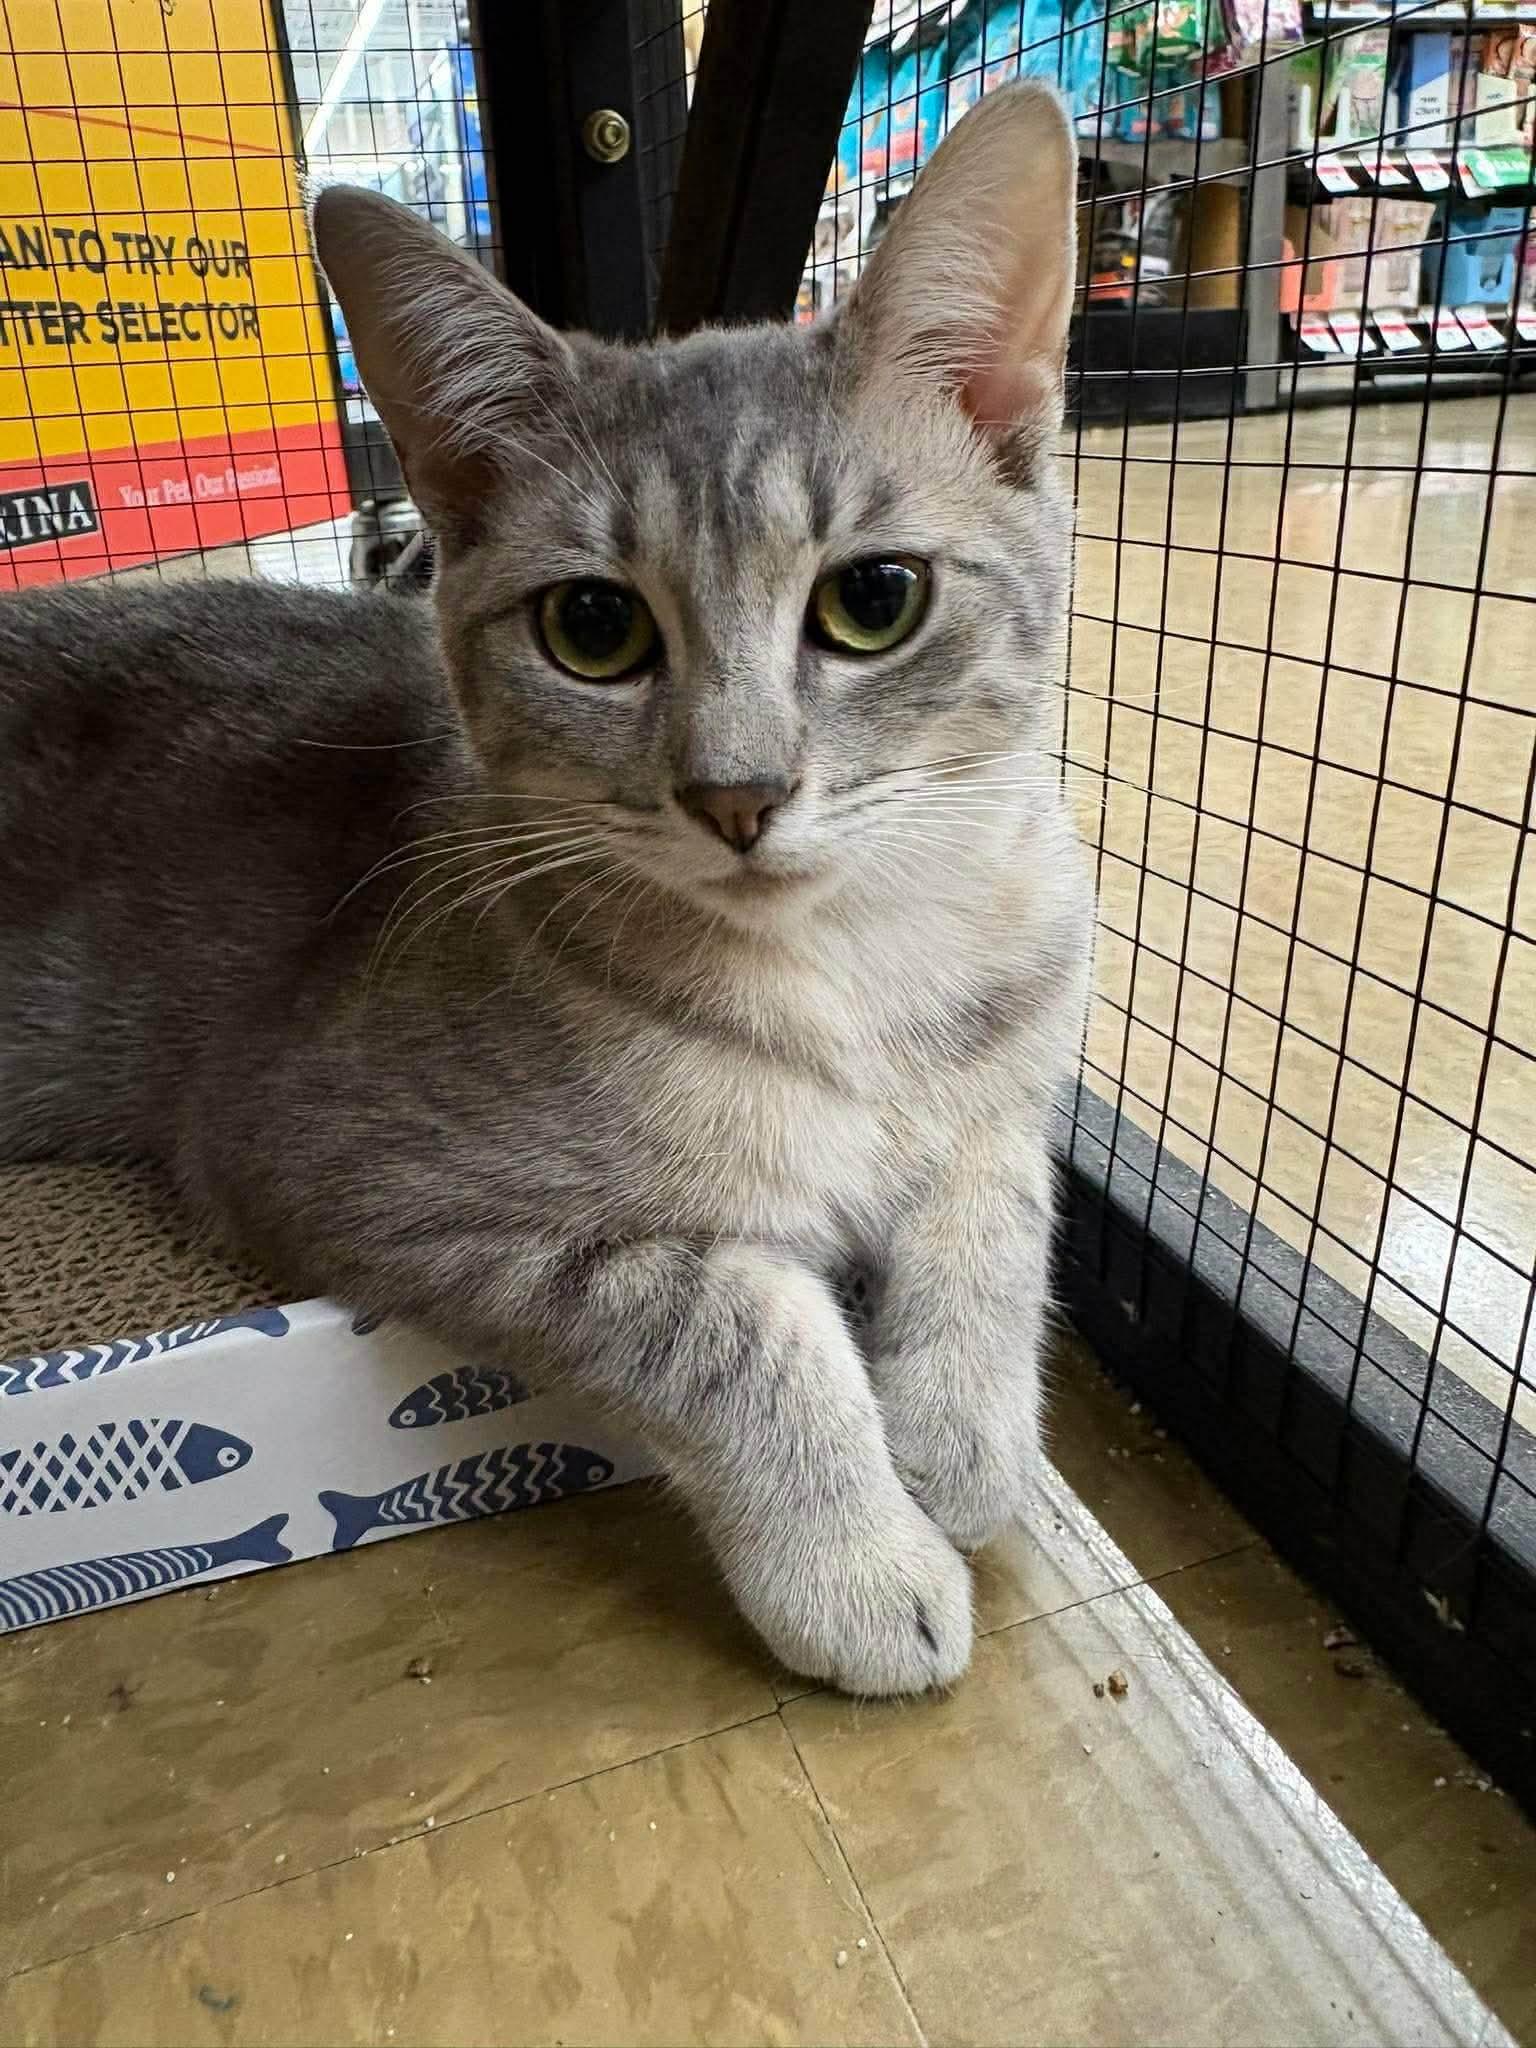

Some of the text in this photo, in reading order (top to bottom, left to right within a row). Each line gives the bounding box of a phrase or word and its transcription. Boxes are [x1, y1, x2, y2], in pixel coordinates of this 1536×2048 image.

[52, 227, 107, 274] TO
[112, 232, 176, 276] TRY
[186, 236, 251, 278] OUR
[97, 301, 260, 344] SELECTOR
